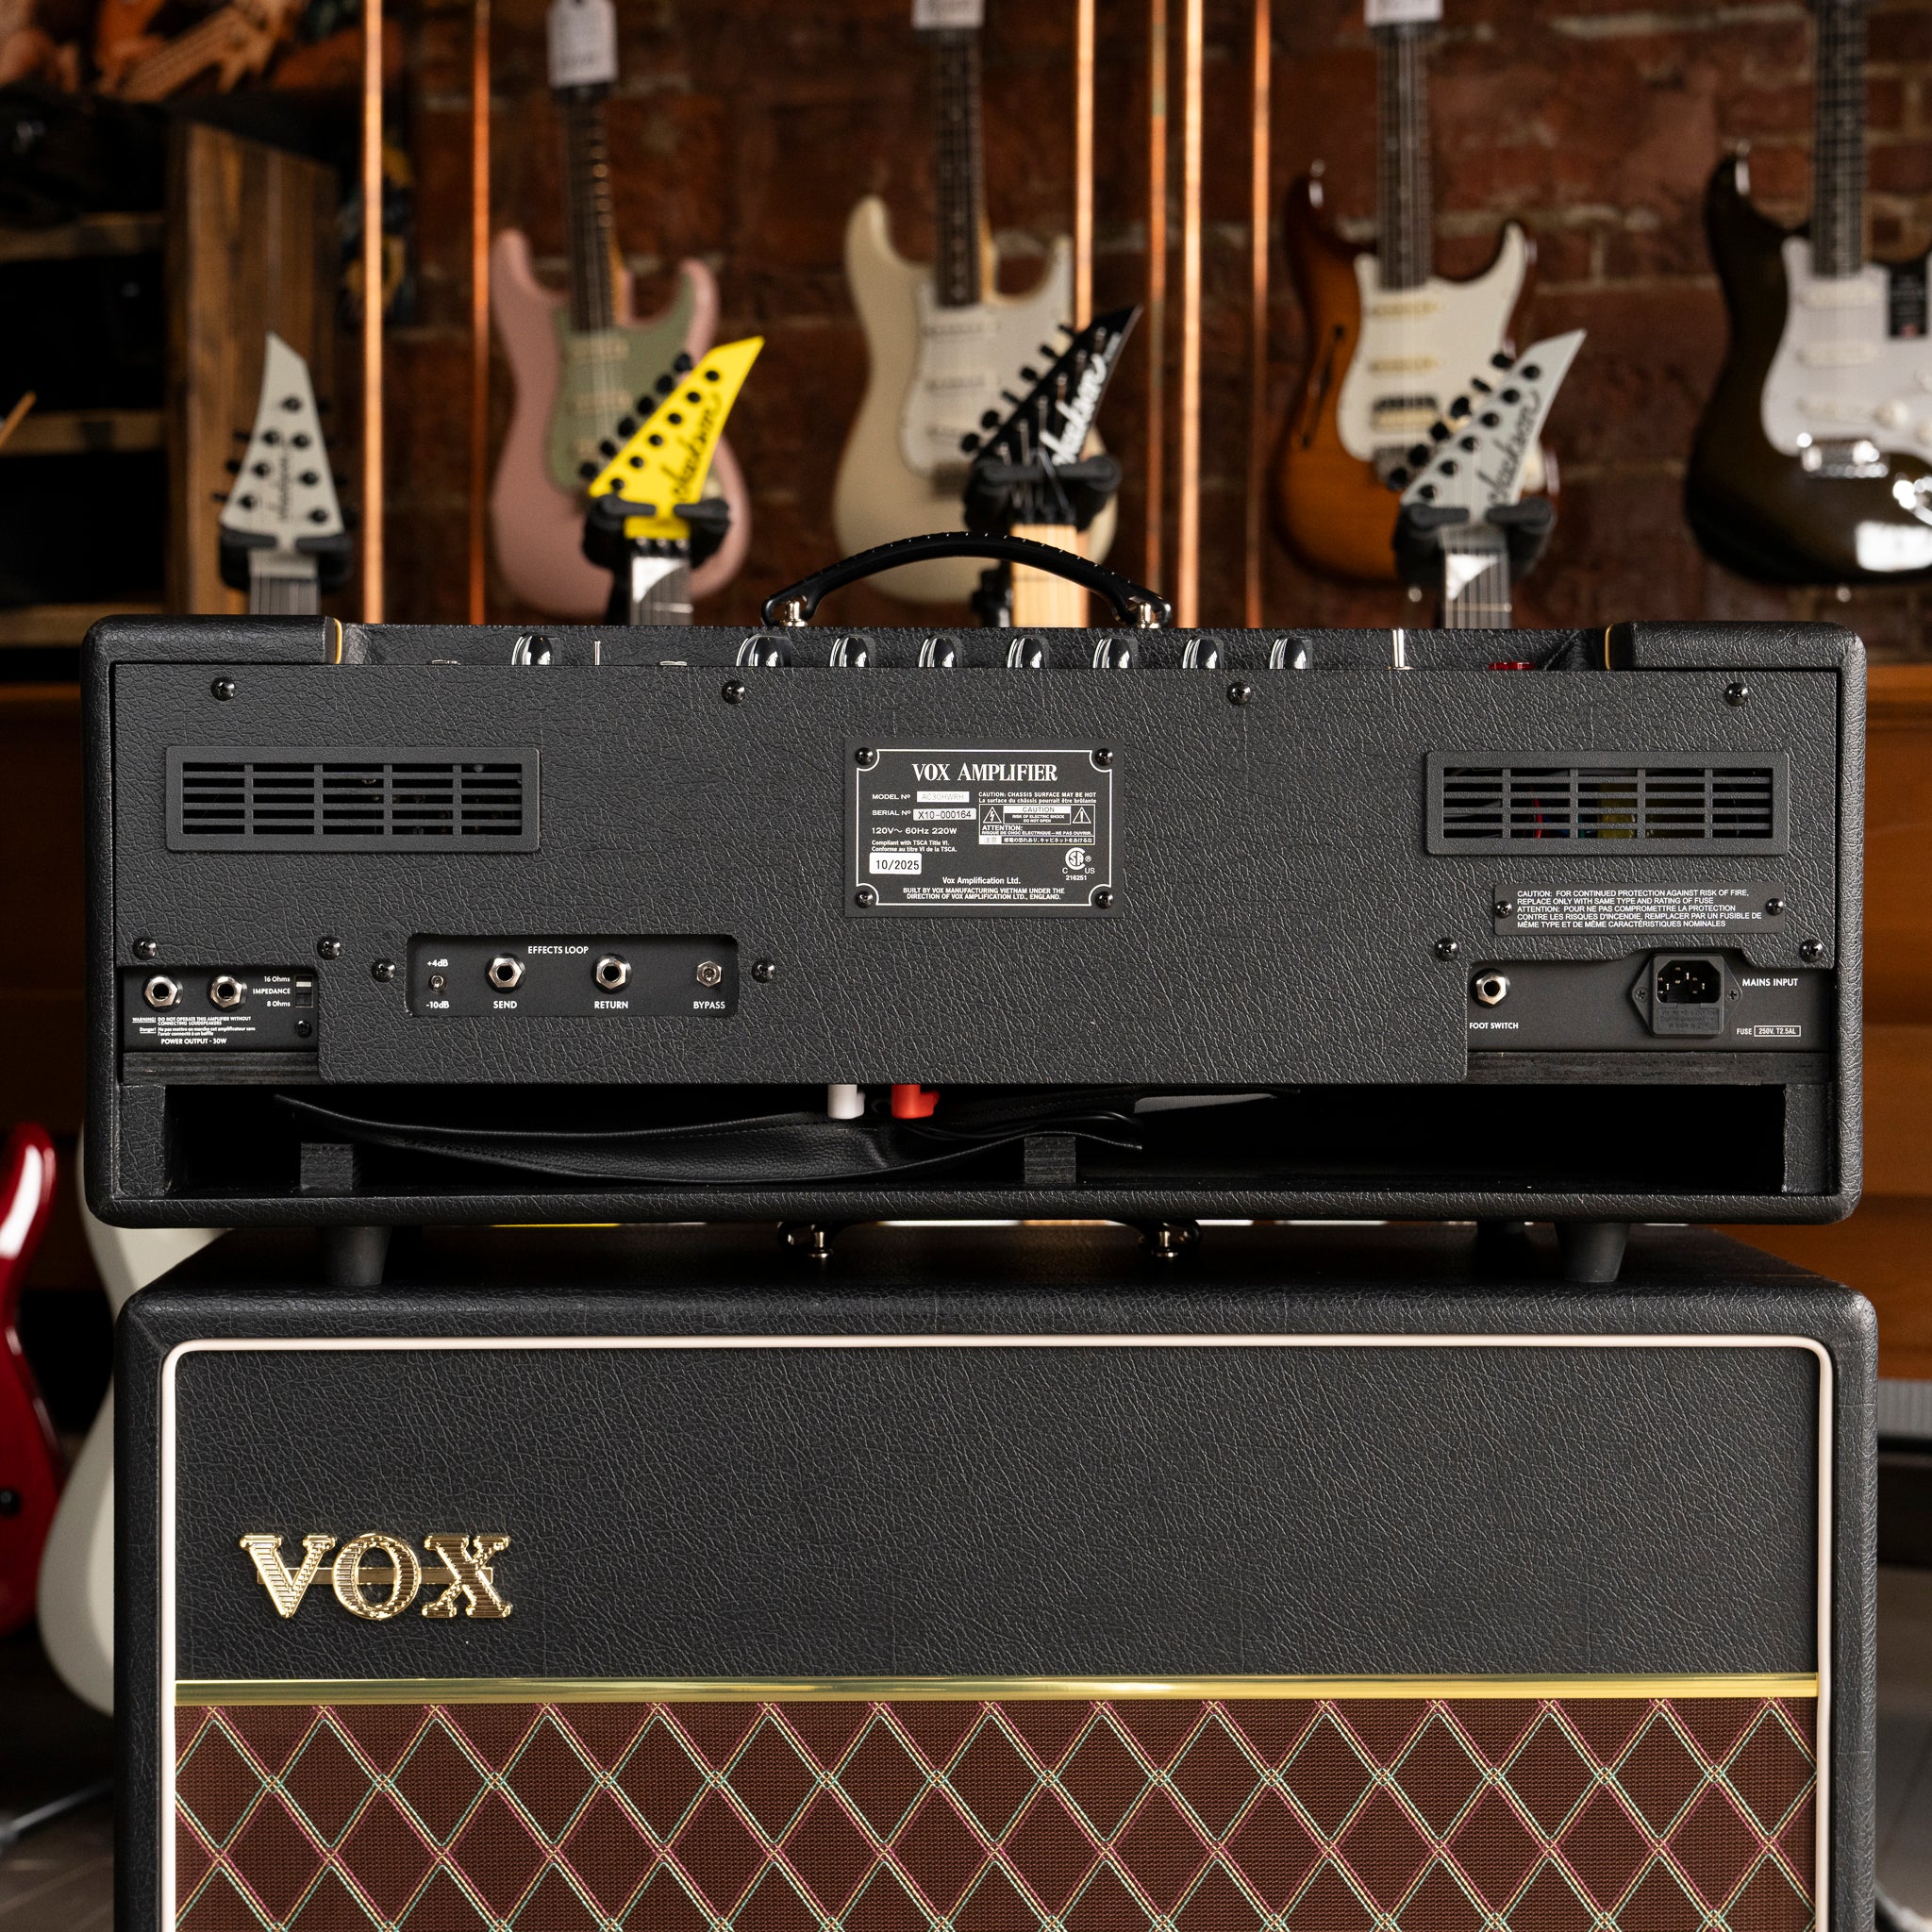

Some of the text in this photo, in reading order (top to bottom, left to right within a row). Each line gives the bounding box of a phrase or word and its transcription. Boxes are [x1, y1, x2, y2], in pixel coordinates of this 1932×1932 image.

[911, 763, 1058, 781] VOX AMPLIFIER
[918, 810, 971, 819] X10-000164
[876, 860, 920, 870] 10/2025
[957, 876, 1005, 885] Amplification
[527, 946, 589, 955] EFFECTS LOOP
[1741, 978, 1798, 987] MAINS INPUT
[492, 1001, 517, 1009] SEND
[594, 1001, 629, 1009] RETURN
[693, 1001, 725, 1009] BYPASS
[240, 1532, 513, 1621] VOX
